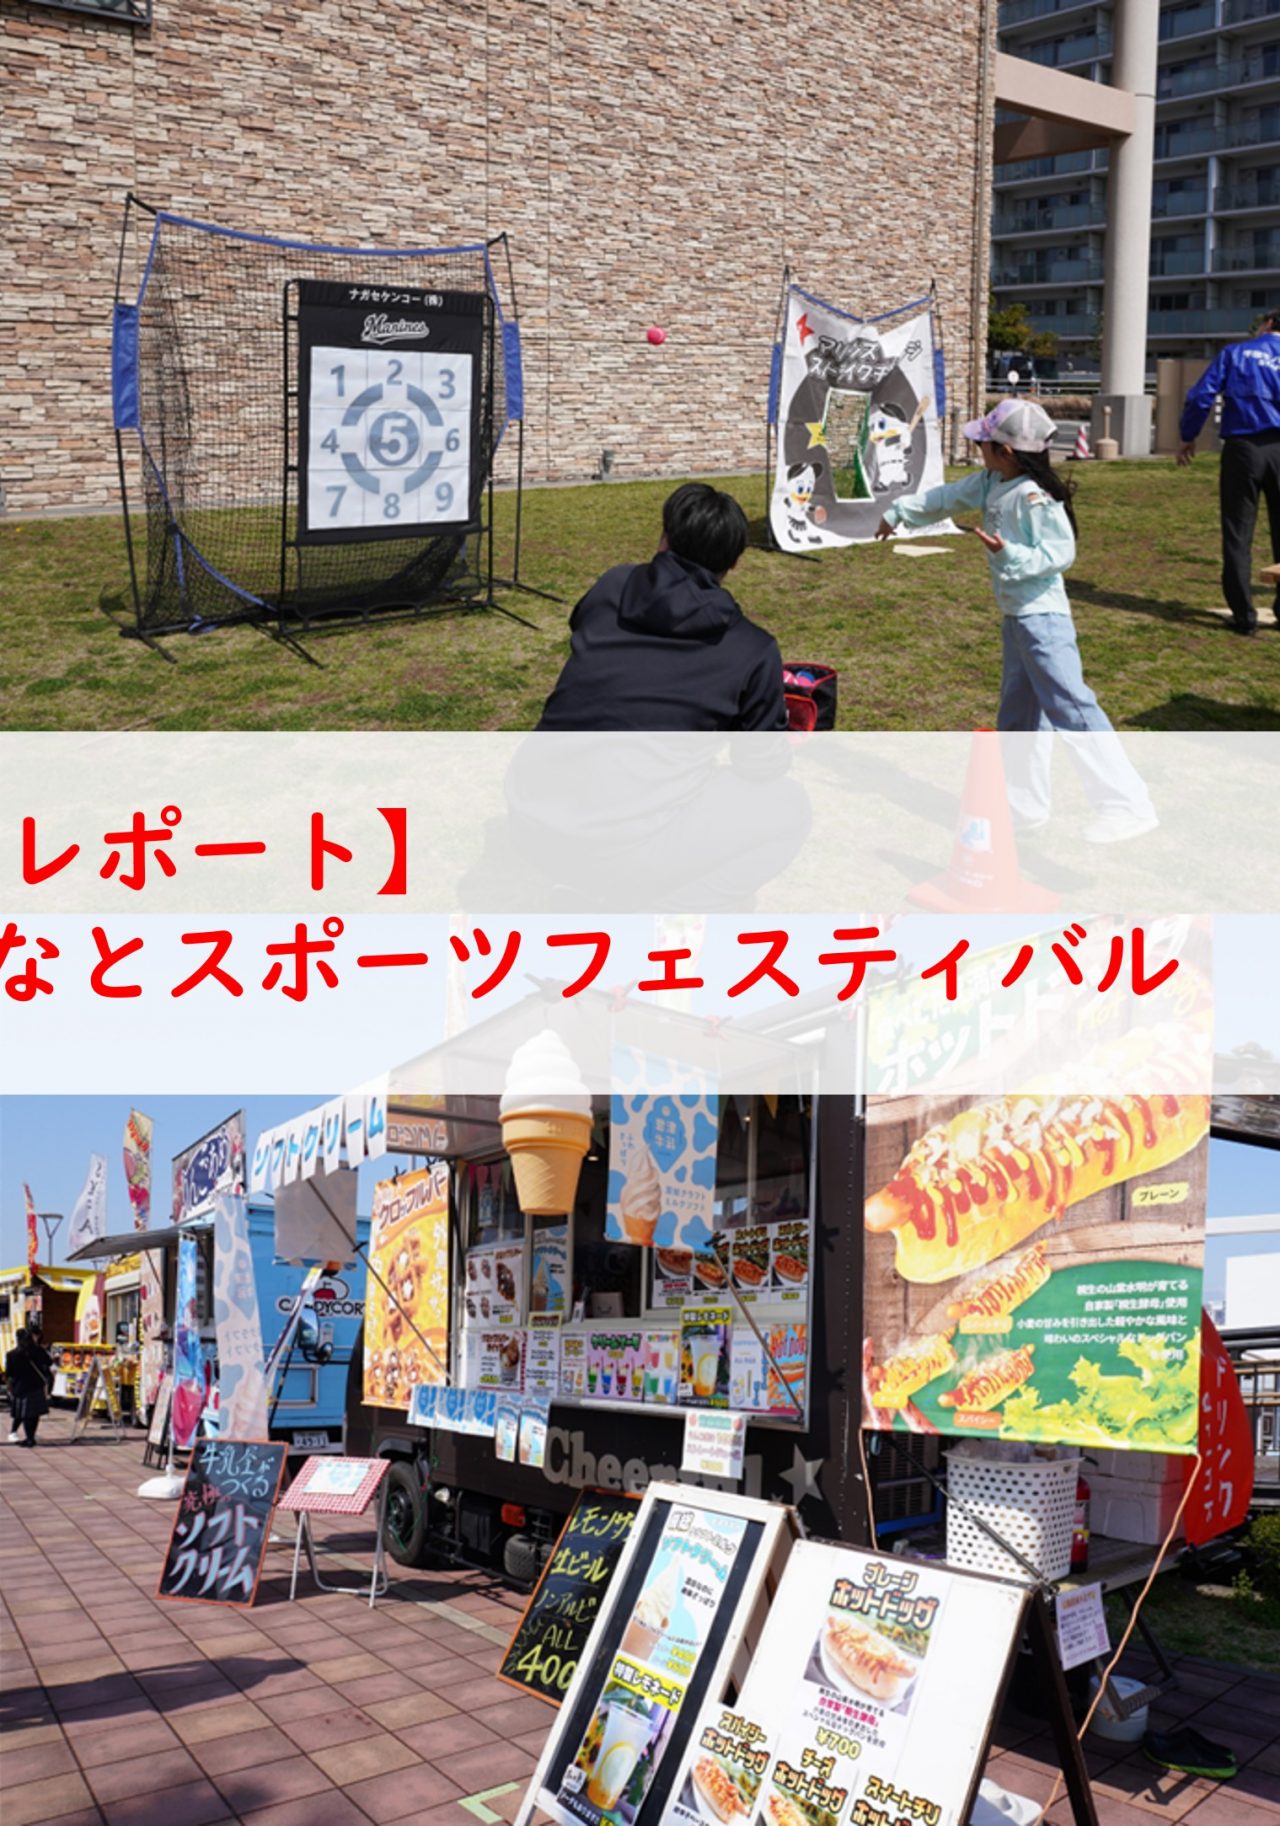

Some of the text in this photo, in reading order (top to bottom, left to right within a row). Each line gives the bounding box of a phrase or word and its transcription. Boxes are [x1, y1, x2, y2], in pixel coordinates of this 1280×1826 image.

[361, 313, 430, 344] Marines
[330, 359, 456, 400] 1 2 3
[320, 417, 460, 460] 4 5 6
[325, 481, 455, 519] 7 8 9
[254, 1096, 386, 1177] ソフトクリーム
[220, 1477, 271, 1498] つくる
[175, 1503, 261, 1549] ソフト
[169, 1546, 255, 1596] クリーム
[550, 1547, 610, 1583] 生ビール
[863, 1562, 919, 1594] プレーン
[534, 1588, 599, 1623] ノンアルビ
[829, 1577, 940, 1631] ホットドッグ
[542, 1623, 578, 1651] ALL
[612, 1659, 682, 1706] 特製レモネード
[718, 1711, 767, 1744] スパイシー
[814, 1725, 862, 1761] ¥700
[700, 1727, 771, 1776] ホットドッグ
[800, 1747, 838, 1778] チーズ
[771, 1760, 849, 1814] ホットドッグ
[865, 1774, 943, 1826] スイートチリ
